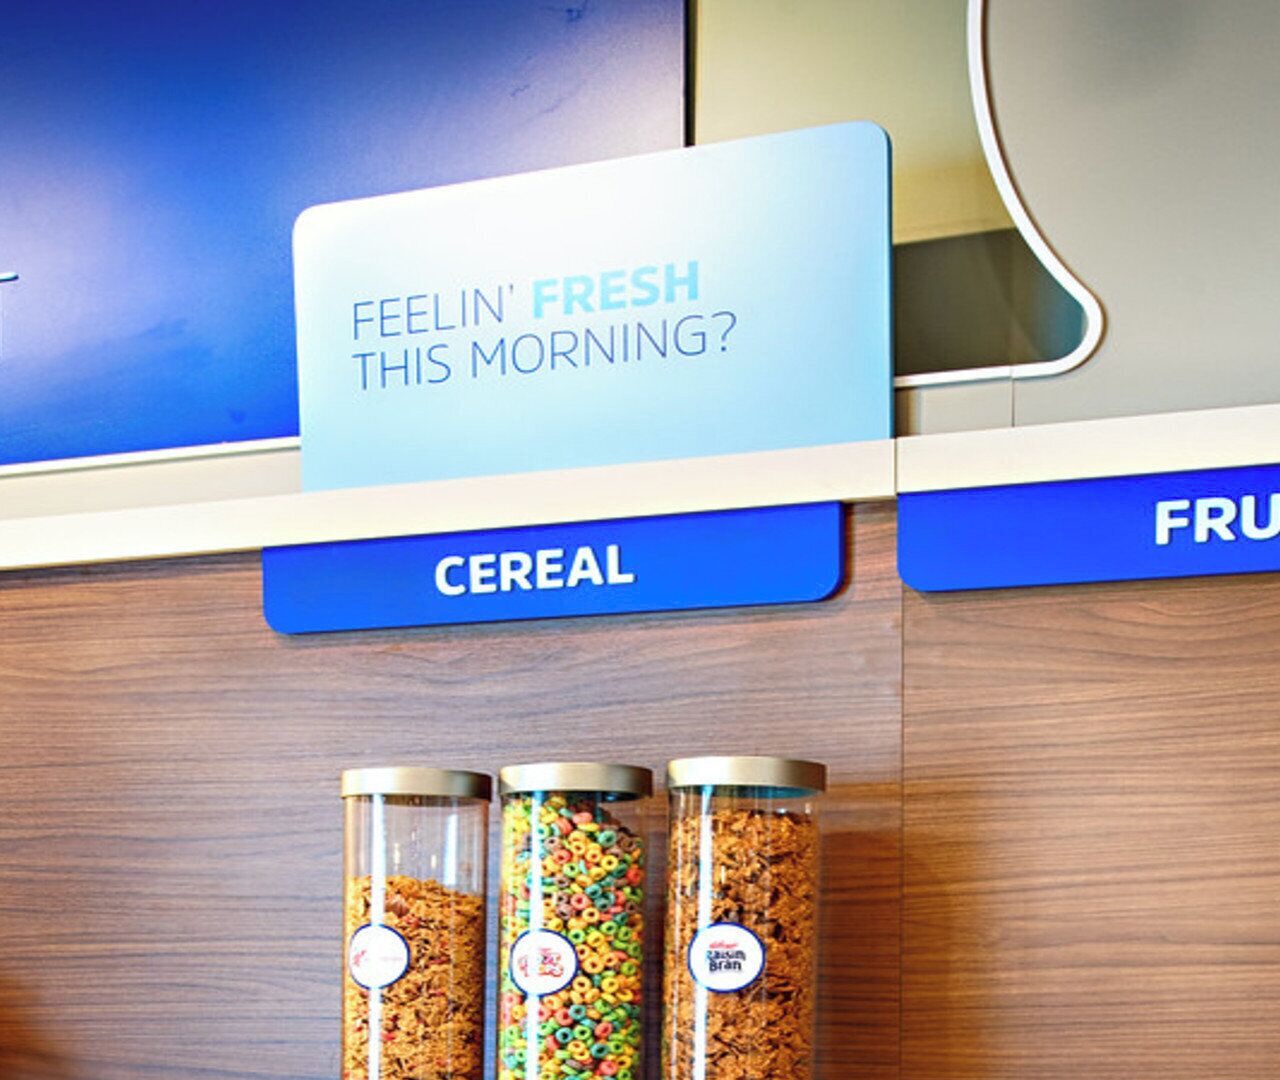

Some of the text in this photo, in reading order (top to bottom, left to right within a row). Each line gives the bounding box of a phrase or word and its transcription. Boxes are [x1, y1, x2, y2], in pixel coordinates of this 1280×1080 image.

[532, 260, 700, 319] FRESH
[352, 311, 737, 391] THIS MORNING?
[434, 544, 637, 596] CEREAL
